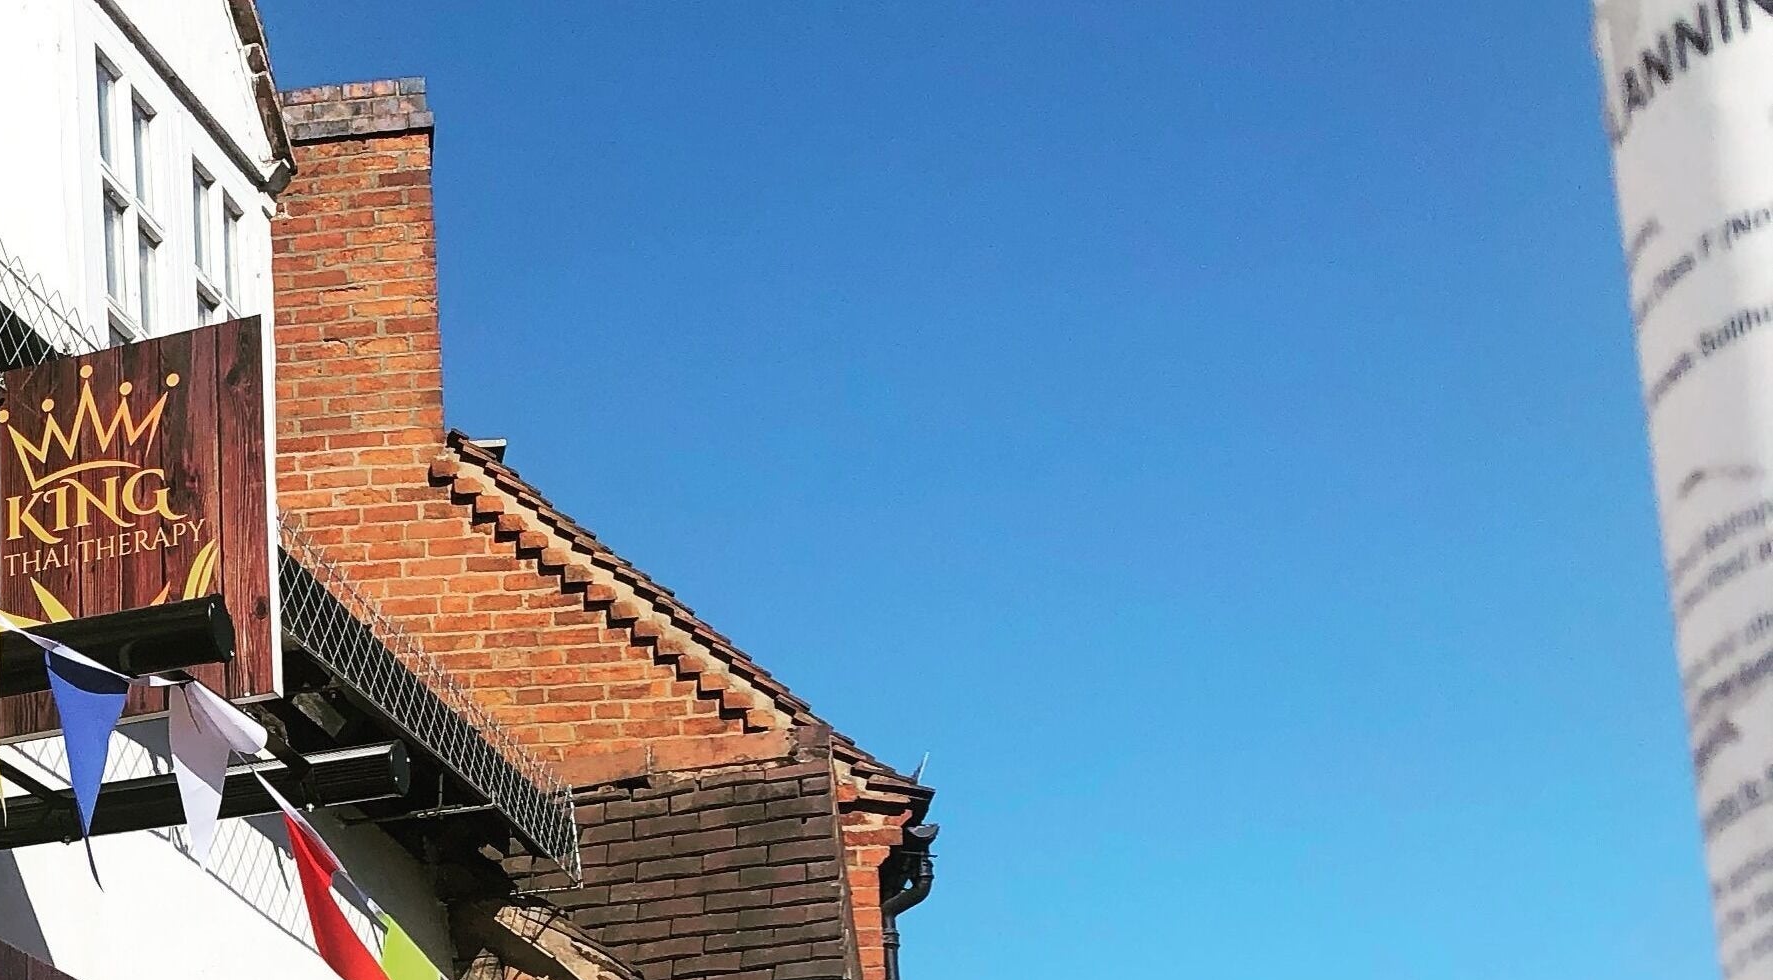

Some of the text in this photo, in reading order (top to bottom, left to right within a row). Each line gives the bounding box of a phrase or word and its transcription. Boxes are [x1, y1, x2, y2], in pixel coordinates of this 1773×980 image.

[5, 467, 188, 545] KING
[3, 518, 207, 578] THAI THERAPY
